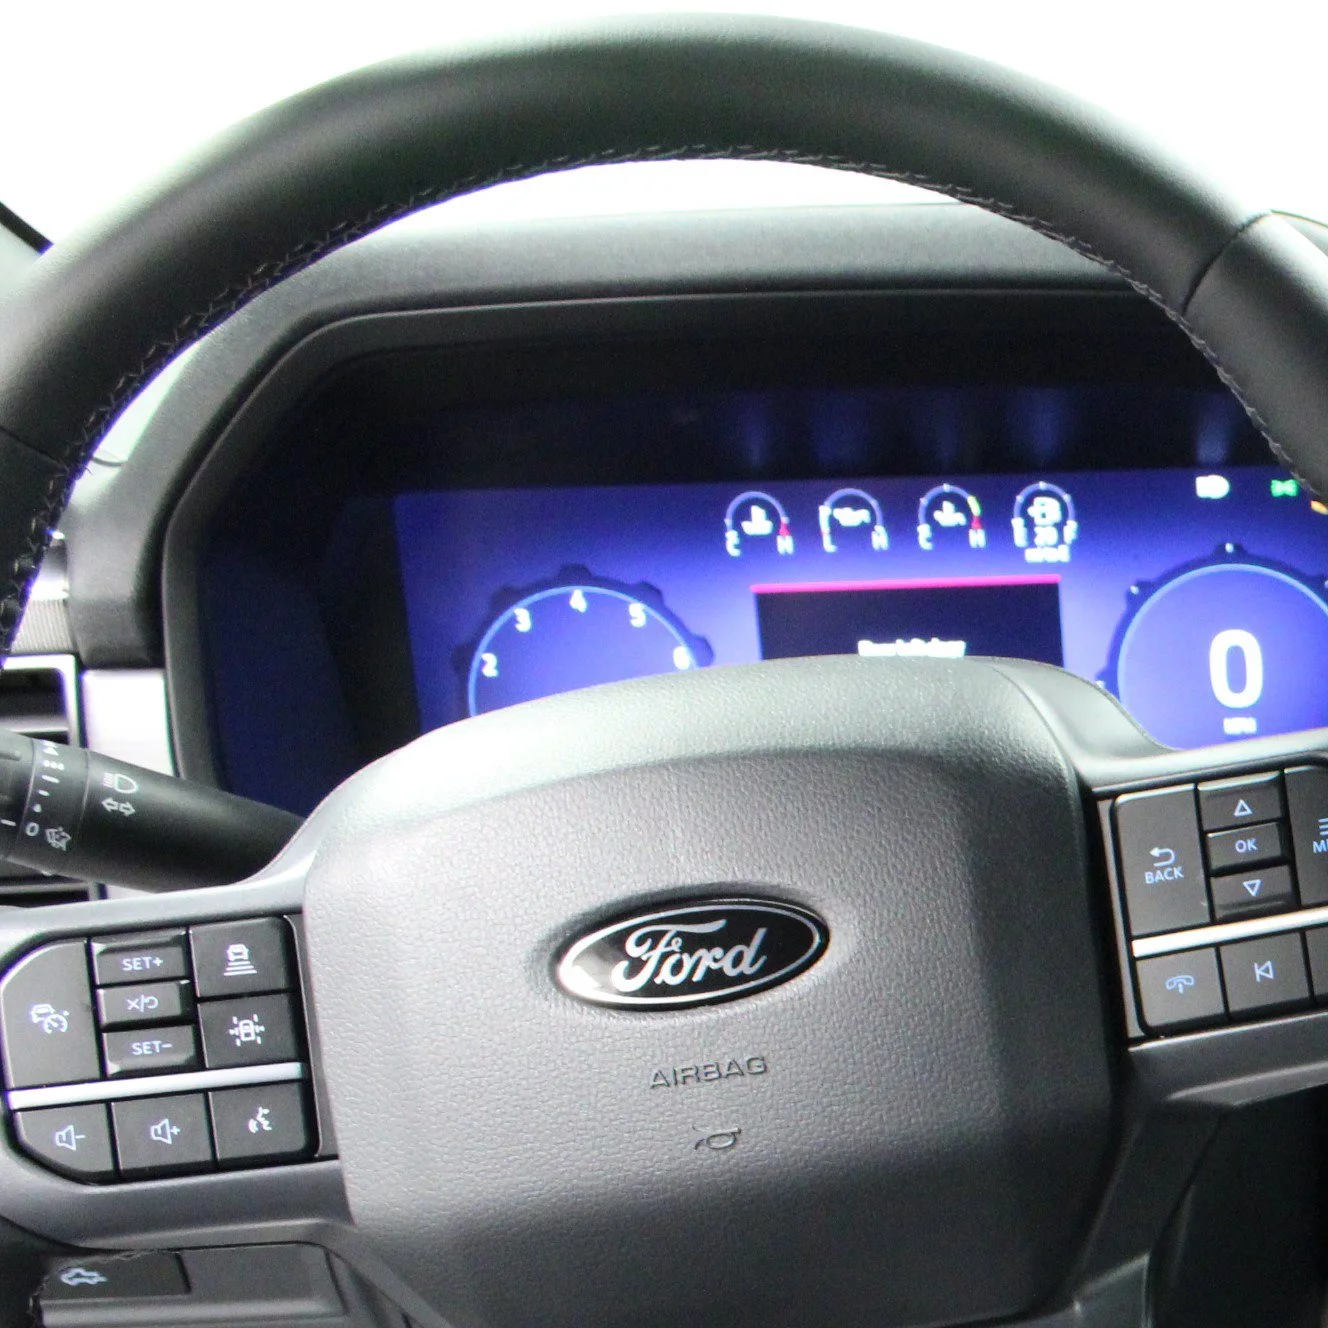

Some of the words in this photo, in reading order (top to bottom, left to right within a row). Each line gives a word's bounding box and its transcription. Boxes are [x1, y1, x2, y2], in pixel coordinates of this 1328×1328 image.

[569, 590, 587, 612] 4
[513, 608, 532, 633] 3
[480, 653, 498, 677] 2
[1209, 629, 1264, 709] 0
[1235, 839, 1258, 853] OK
[1145, 866, 1184, 884] BACK
[122, 956, 164, 972] SET+
[611, 919, 768, 993] Ford
[650, 1056, 768, 1090] AIRBAG
